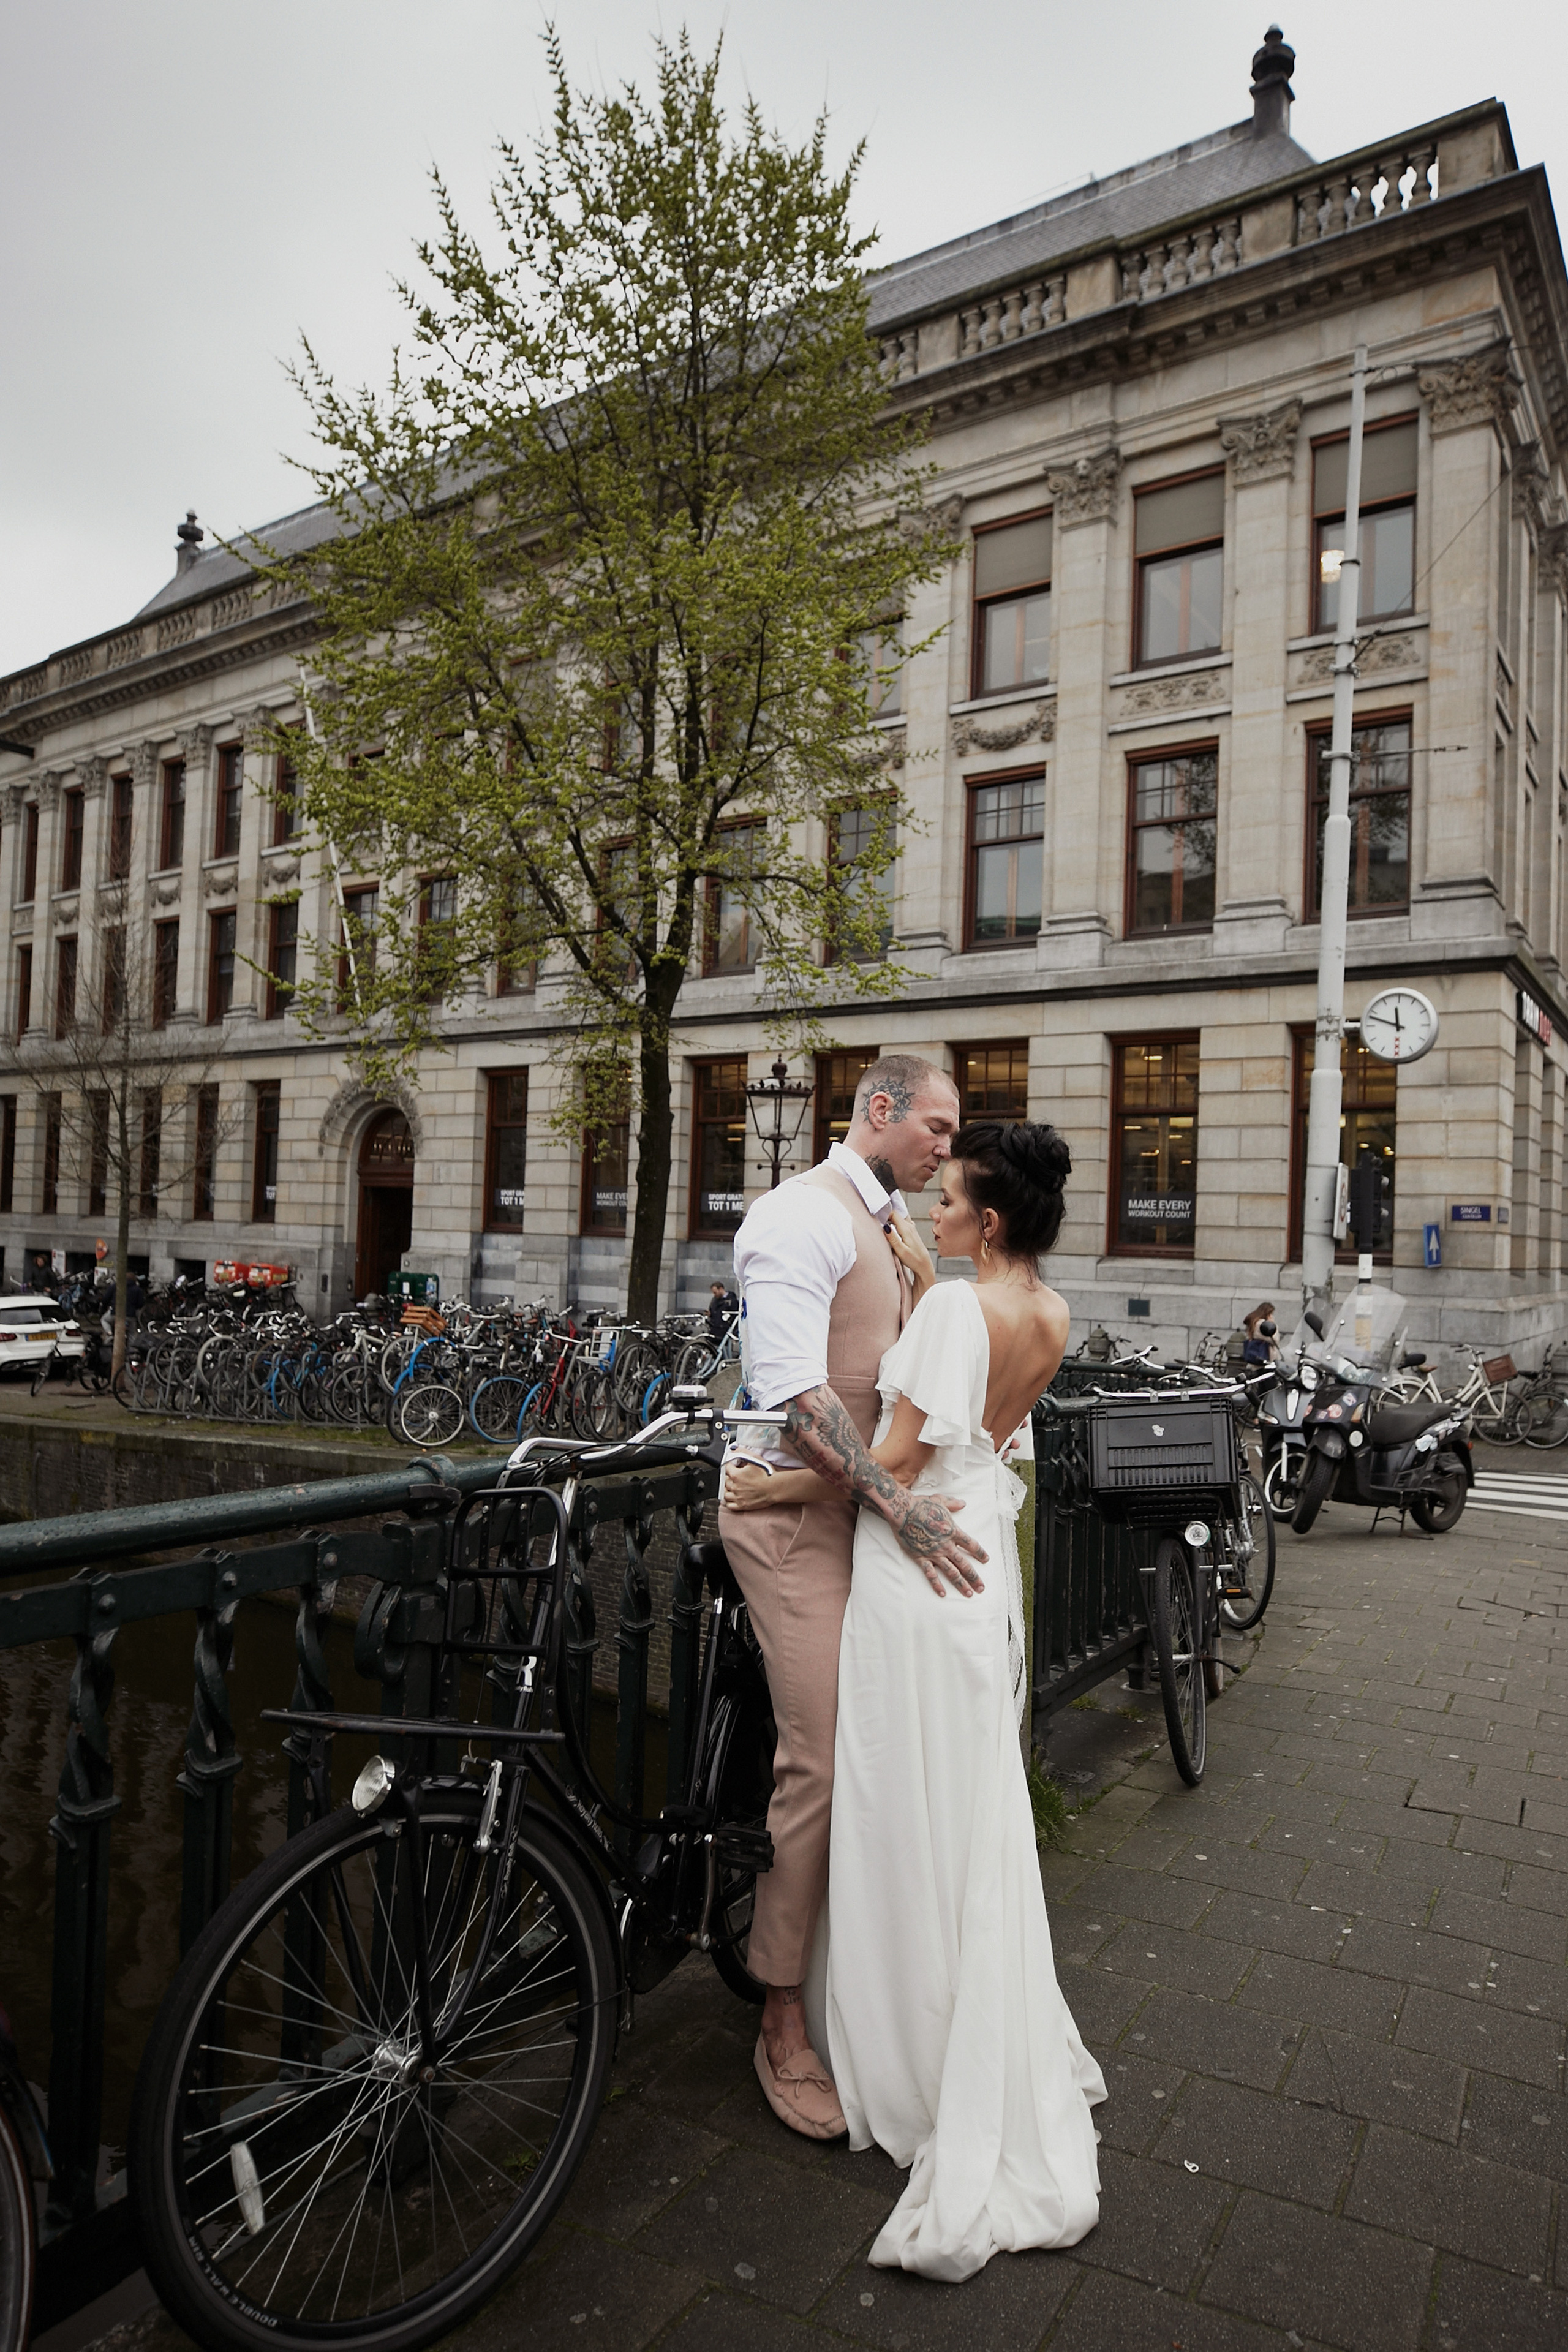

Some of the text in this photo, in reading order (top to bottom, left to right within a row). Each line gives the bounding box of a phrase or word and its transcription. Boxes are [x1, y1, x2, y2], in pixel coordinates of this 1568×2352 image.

[500, 1196, 513, 1205] TOT
[514, 1197, 518, 1205] 1
[1128, 1200, 1191, 1210] MAKE EVERY
[708, 1201, 724, 1210] TOT
[725, 1202, 729, 1211] 1
[188, 2236, 278, 2328] DOUBLE WALL RIM
